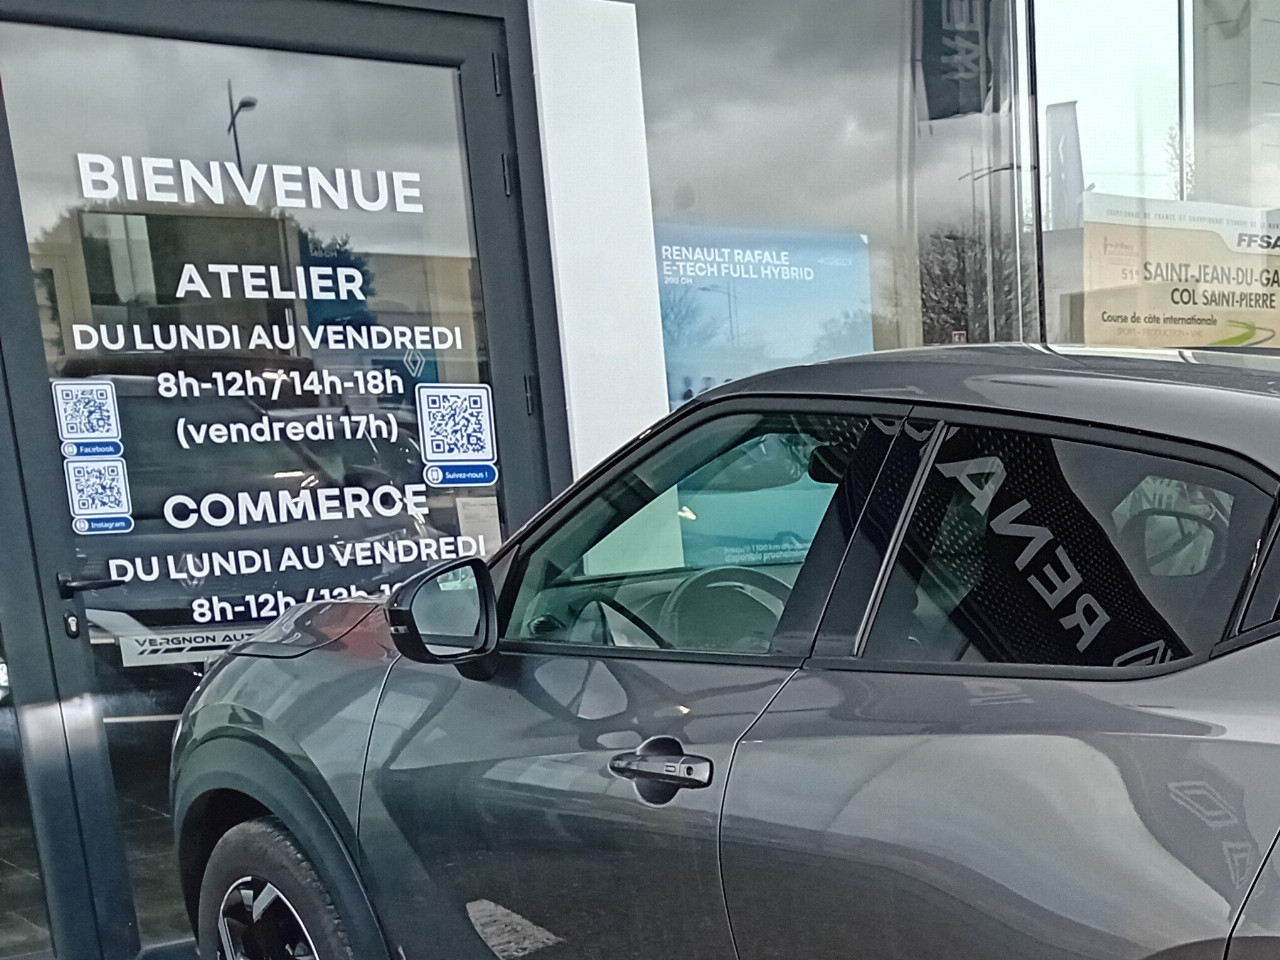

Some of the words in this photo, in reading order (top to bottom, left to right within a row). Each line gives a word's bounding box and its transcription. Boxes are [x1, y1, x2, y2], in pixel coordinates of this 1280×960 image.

[77, 153, 425, 213] BIENVENUE
[661, 245, 731, 262] RENAULT
[733, 249, 790, 265] RAFALE
[176, 264, 366, 301] ATELIER
[662, 261, 718, 277] E-TECH
[721, 264, 758, 279] FULL
[761, 266, 814, 281] HYBRID
[1170, 288, 1198, 306] COL
[1202, 291, 1276, 309] SAINT-PIERRE
[1101, 311, 1129, 324] Course
[1130, 312, 1142, 323] de
[1163, 313, 1218, 326] internationale
[72, 325, 125, 351] DU
[133, 325, 241, 350] LUNDI
[248, 325, 297, 350] AU
[301, 326, 463, 350] VENDREDI
[157, 369, 267, 398] 8h-12h
[289, 368, 404, 396] 14h-18h
[177, 414, 335, 449] (vendredi
[339, 412, 398, 443] 17h)
[79, 445, 115, 454] Facebook
[445, 471, 484, 480] Suivez-nous
[163, 483, 430, 530] COMMERCE
[91, 520, 126, 530] Instagram
[108, 556, 160, 583] DU
[167, 548, 272, 580] LUNDI
[279, 545, 325, 573] AU
[329, 535, 486, 567] VENDREDI
[192, 590, 297, 623] 8h-12h
[134, 634, 216, 647] VERGNON
[221, 632, 256, 643] AUT
